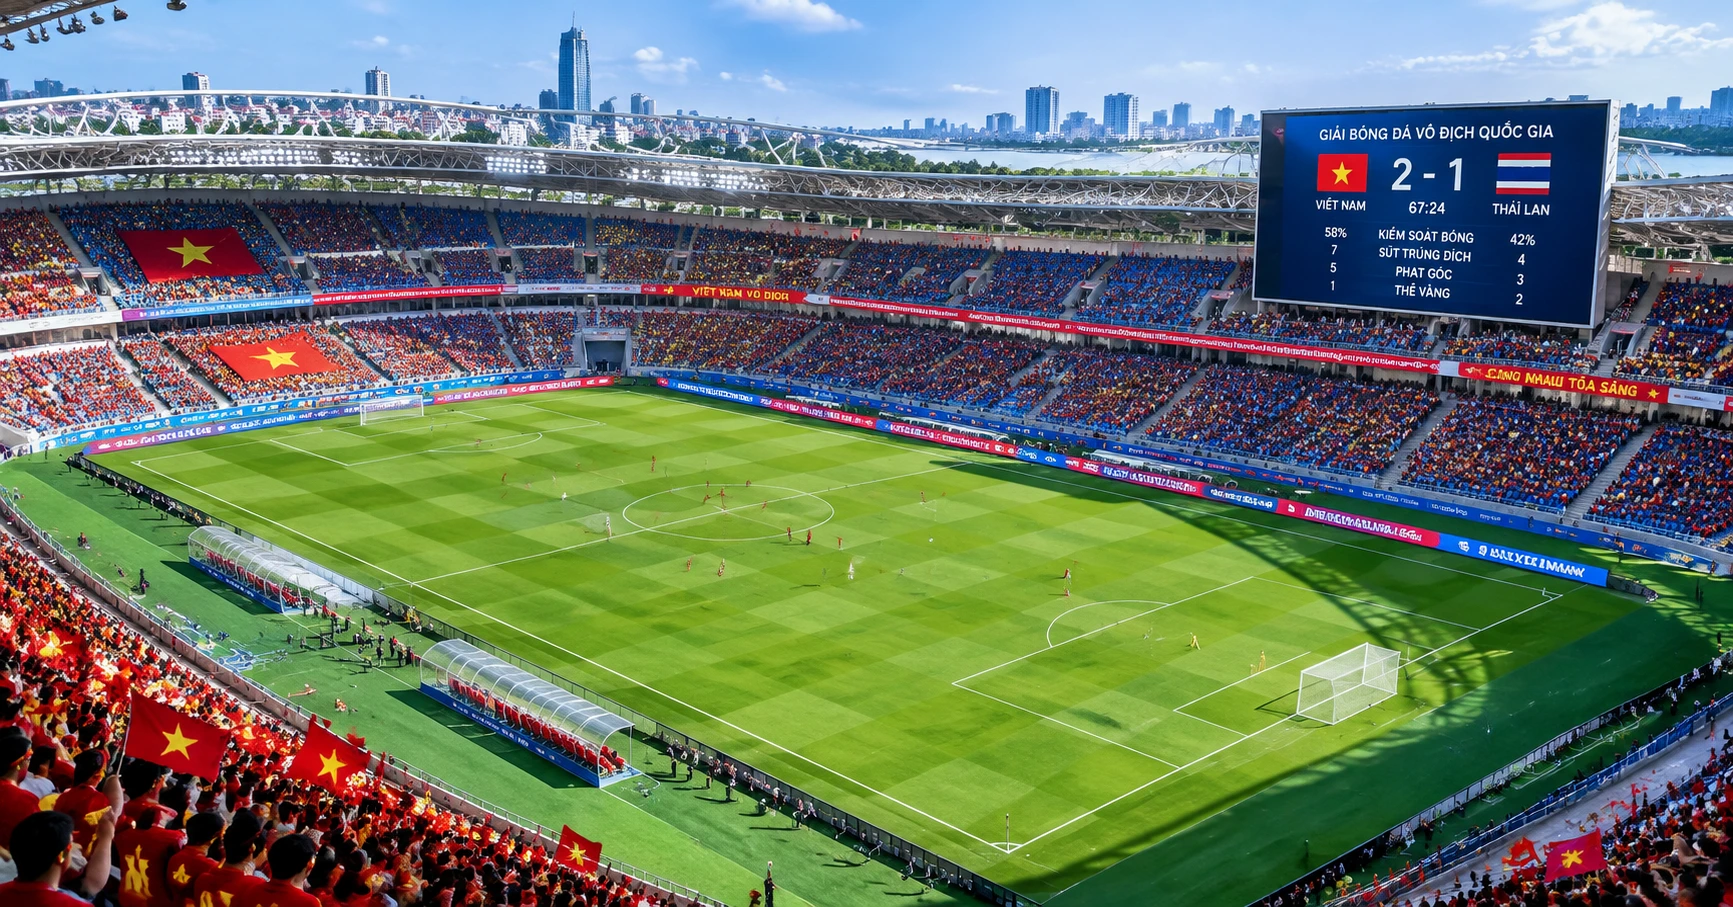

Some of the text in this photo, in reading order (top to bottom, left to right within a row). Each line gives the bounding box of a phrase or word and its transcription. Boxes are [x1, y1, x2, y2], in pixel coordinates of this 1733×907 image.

[1349, 125, 1388, 141] BÓNG
[1392, 124, 1412, 140] ĐÁ
[1439, 126, 1475, 142] ĐỊCH
[1527, 124, 1554, 139] GIA
[1391, 157, 1413, 191] 2
[1448, 157, 1463, 192] 1
[1341, 200, 1366, 212] NAM
[1408, 200, 1446, 215] 67:24
[1524, 203, 1551, 216] LAN
[1324, 226, 1348, 239] 58%
[1441, 230, 1474, 244] BÓNG
[1509, 233, 1536, 246] 42%
[1331, 244, 1338, 255] 7
[1517, 253, 1526, 266] 4
[1330, 261, 1337, 273] 5
[1427, 266, 1453, 280] GÓC
[1330, 280, 1335, 291] 1
[1516, 273, 1525, 286] 3
[1515, 293, 1523, 306] 2
